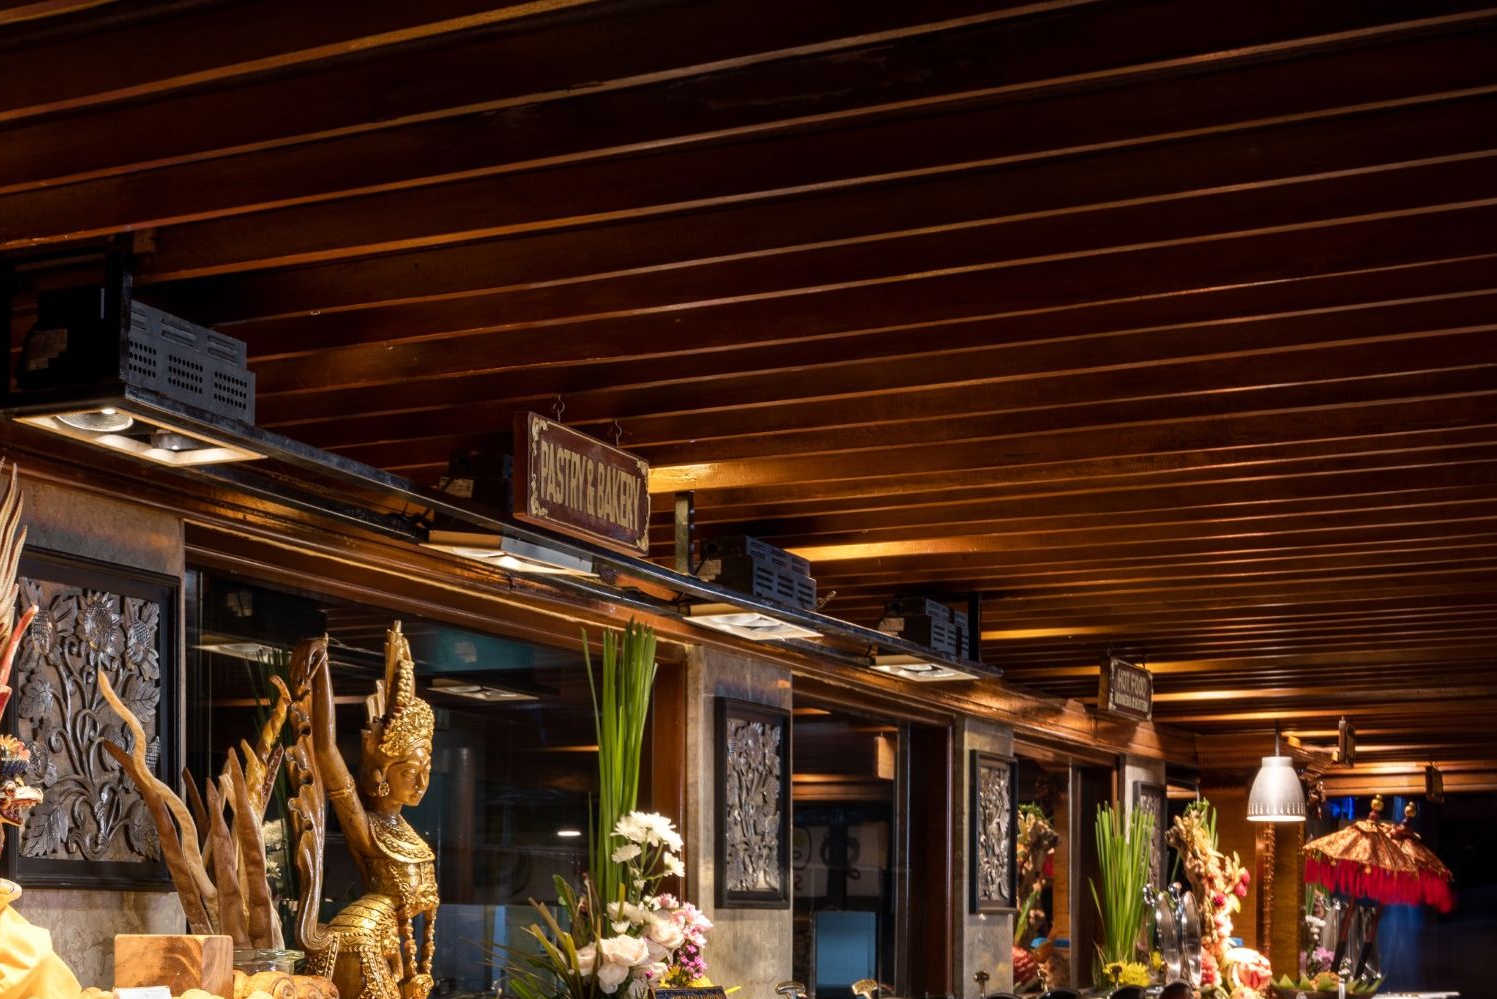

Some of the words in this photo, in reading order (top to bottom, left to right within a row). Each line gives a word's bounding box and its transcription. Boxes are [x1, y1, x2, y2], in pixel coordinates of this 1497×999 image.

[540, 439, 587, 512] PASTRY
[586, 459, 596, 516] &
[597, 462, 641, 531] BAKERY
